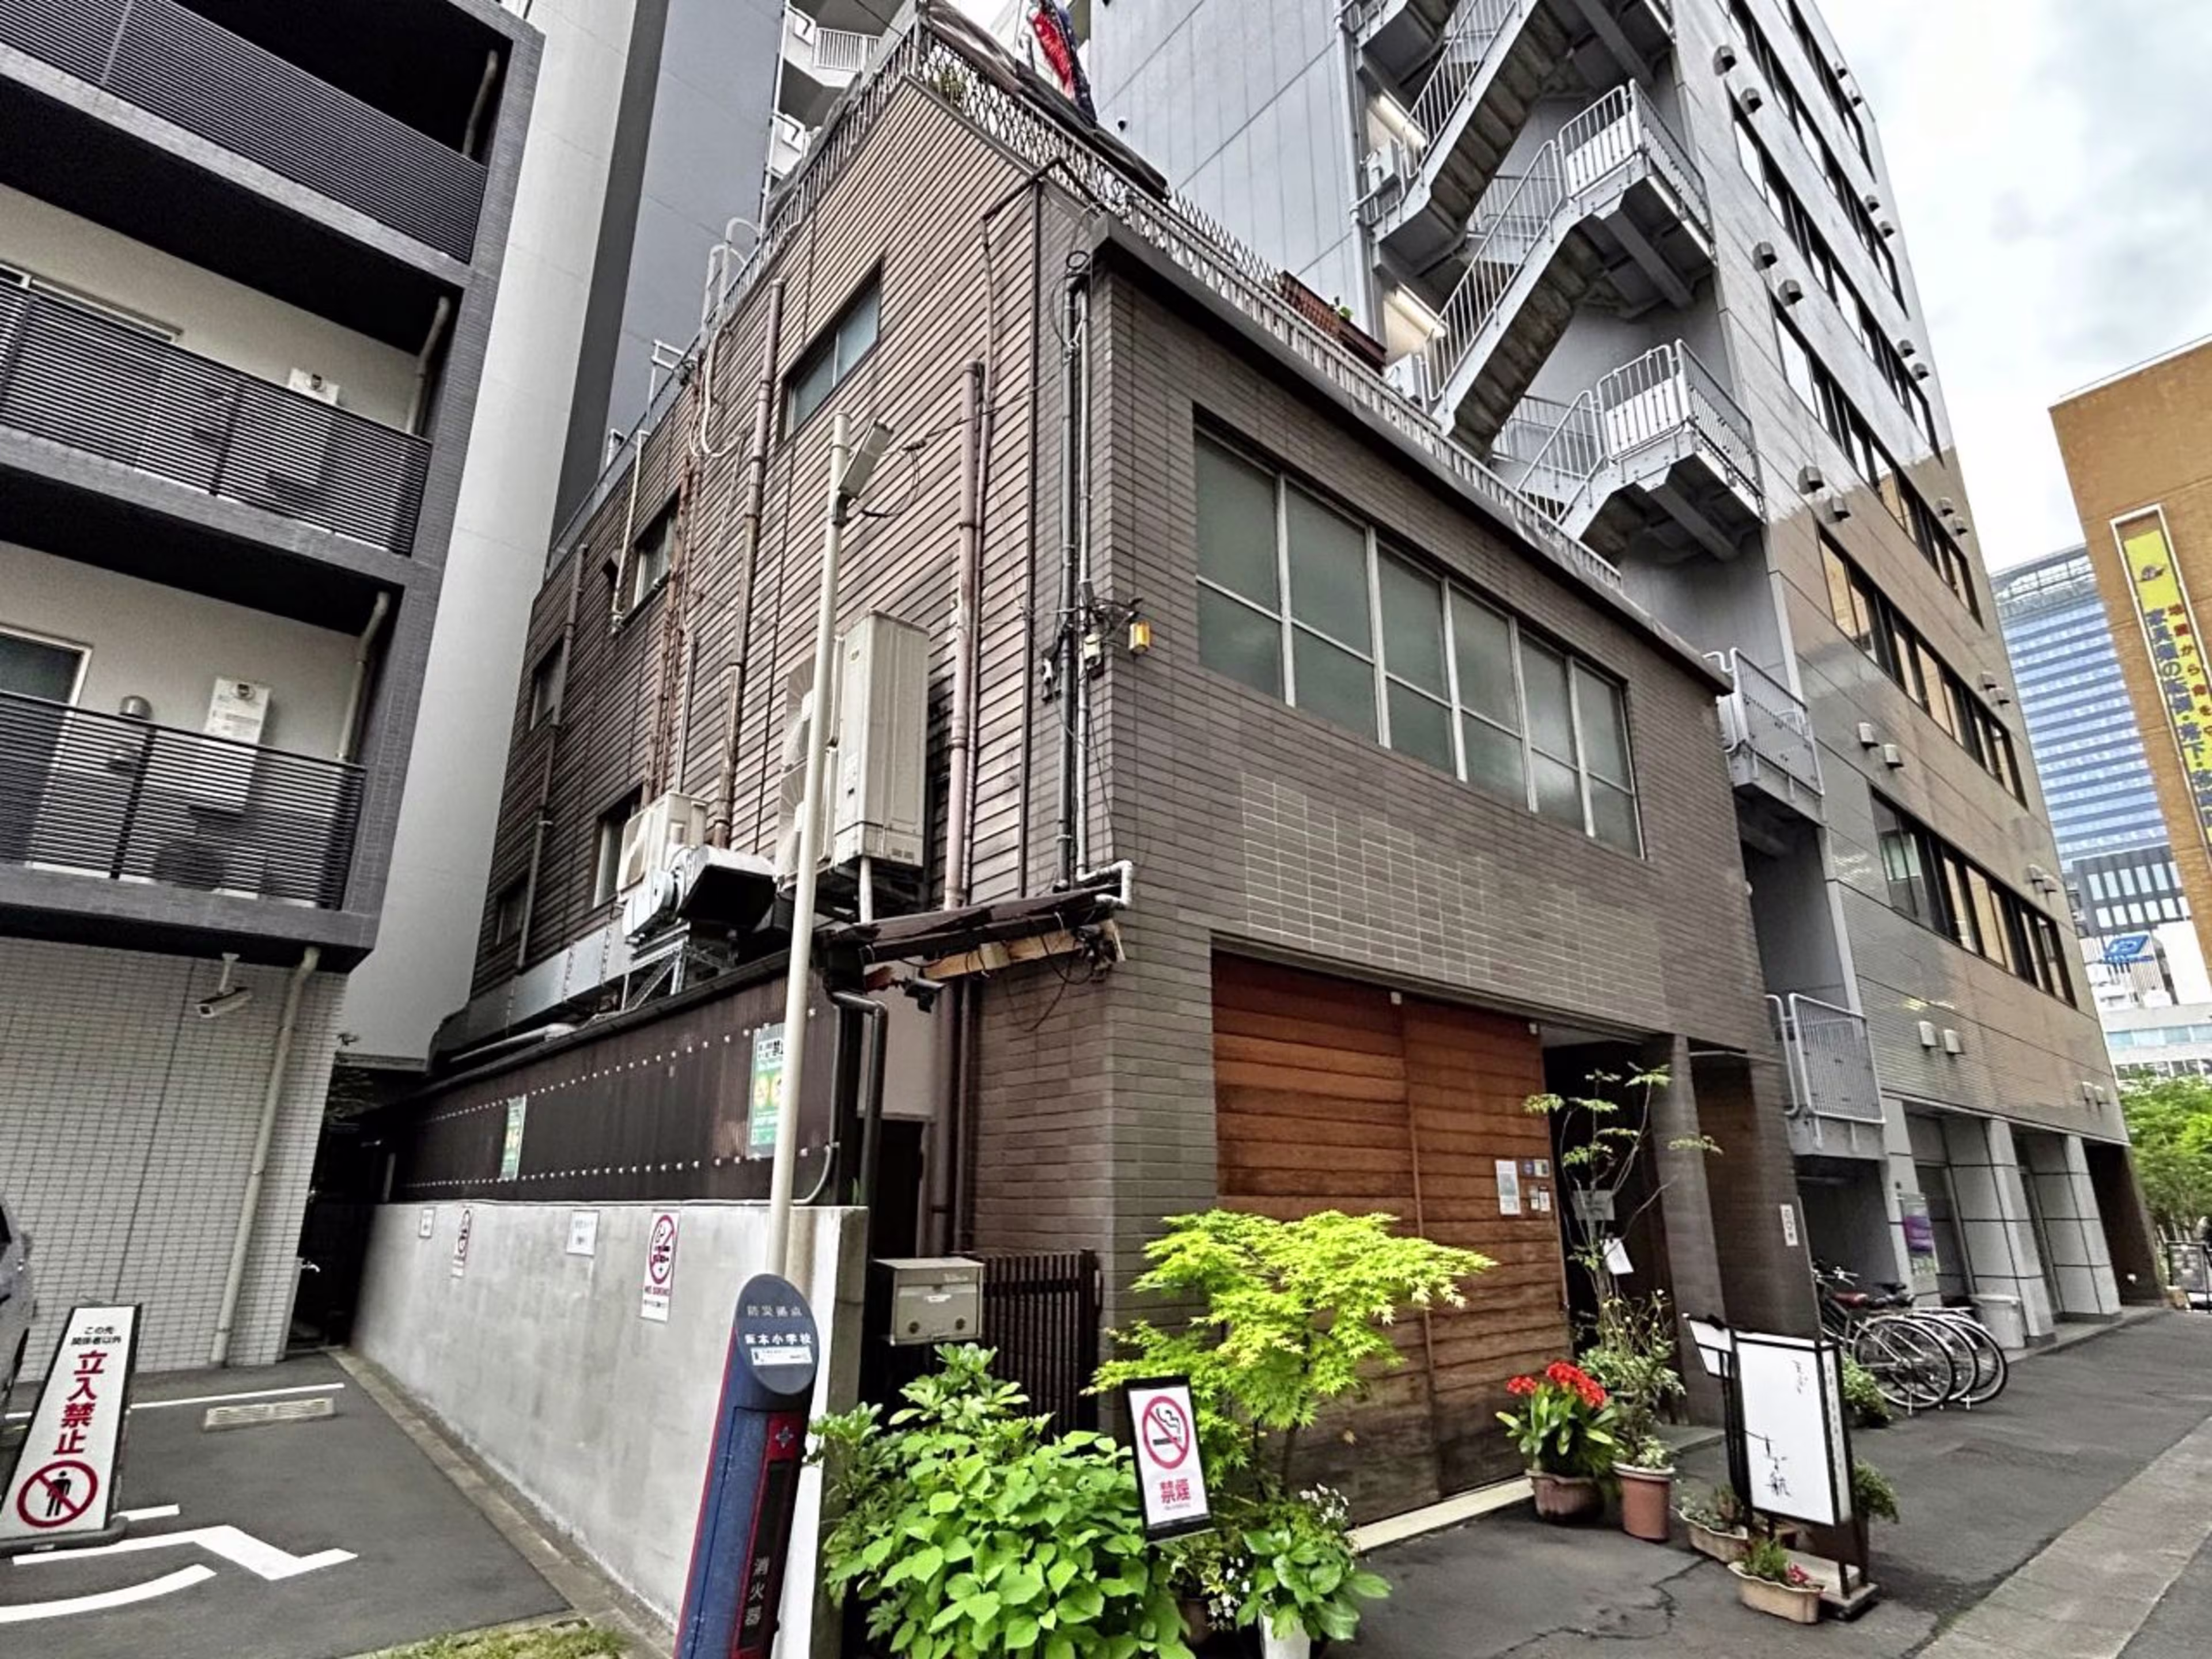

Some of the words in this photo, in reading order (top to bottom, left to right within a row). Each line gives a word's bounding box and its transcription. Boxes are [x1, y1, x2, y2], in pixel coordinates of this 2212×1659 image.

[71, 1335, 122, 1345] 関係者以外
[84, 1326, 114, 1335] この先
[53, 1350, 108, 1456] 立入禁止
[1160, 1478, 1191, 1504] 禁煙
[745, 1556, 770, 1626] 消火器
